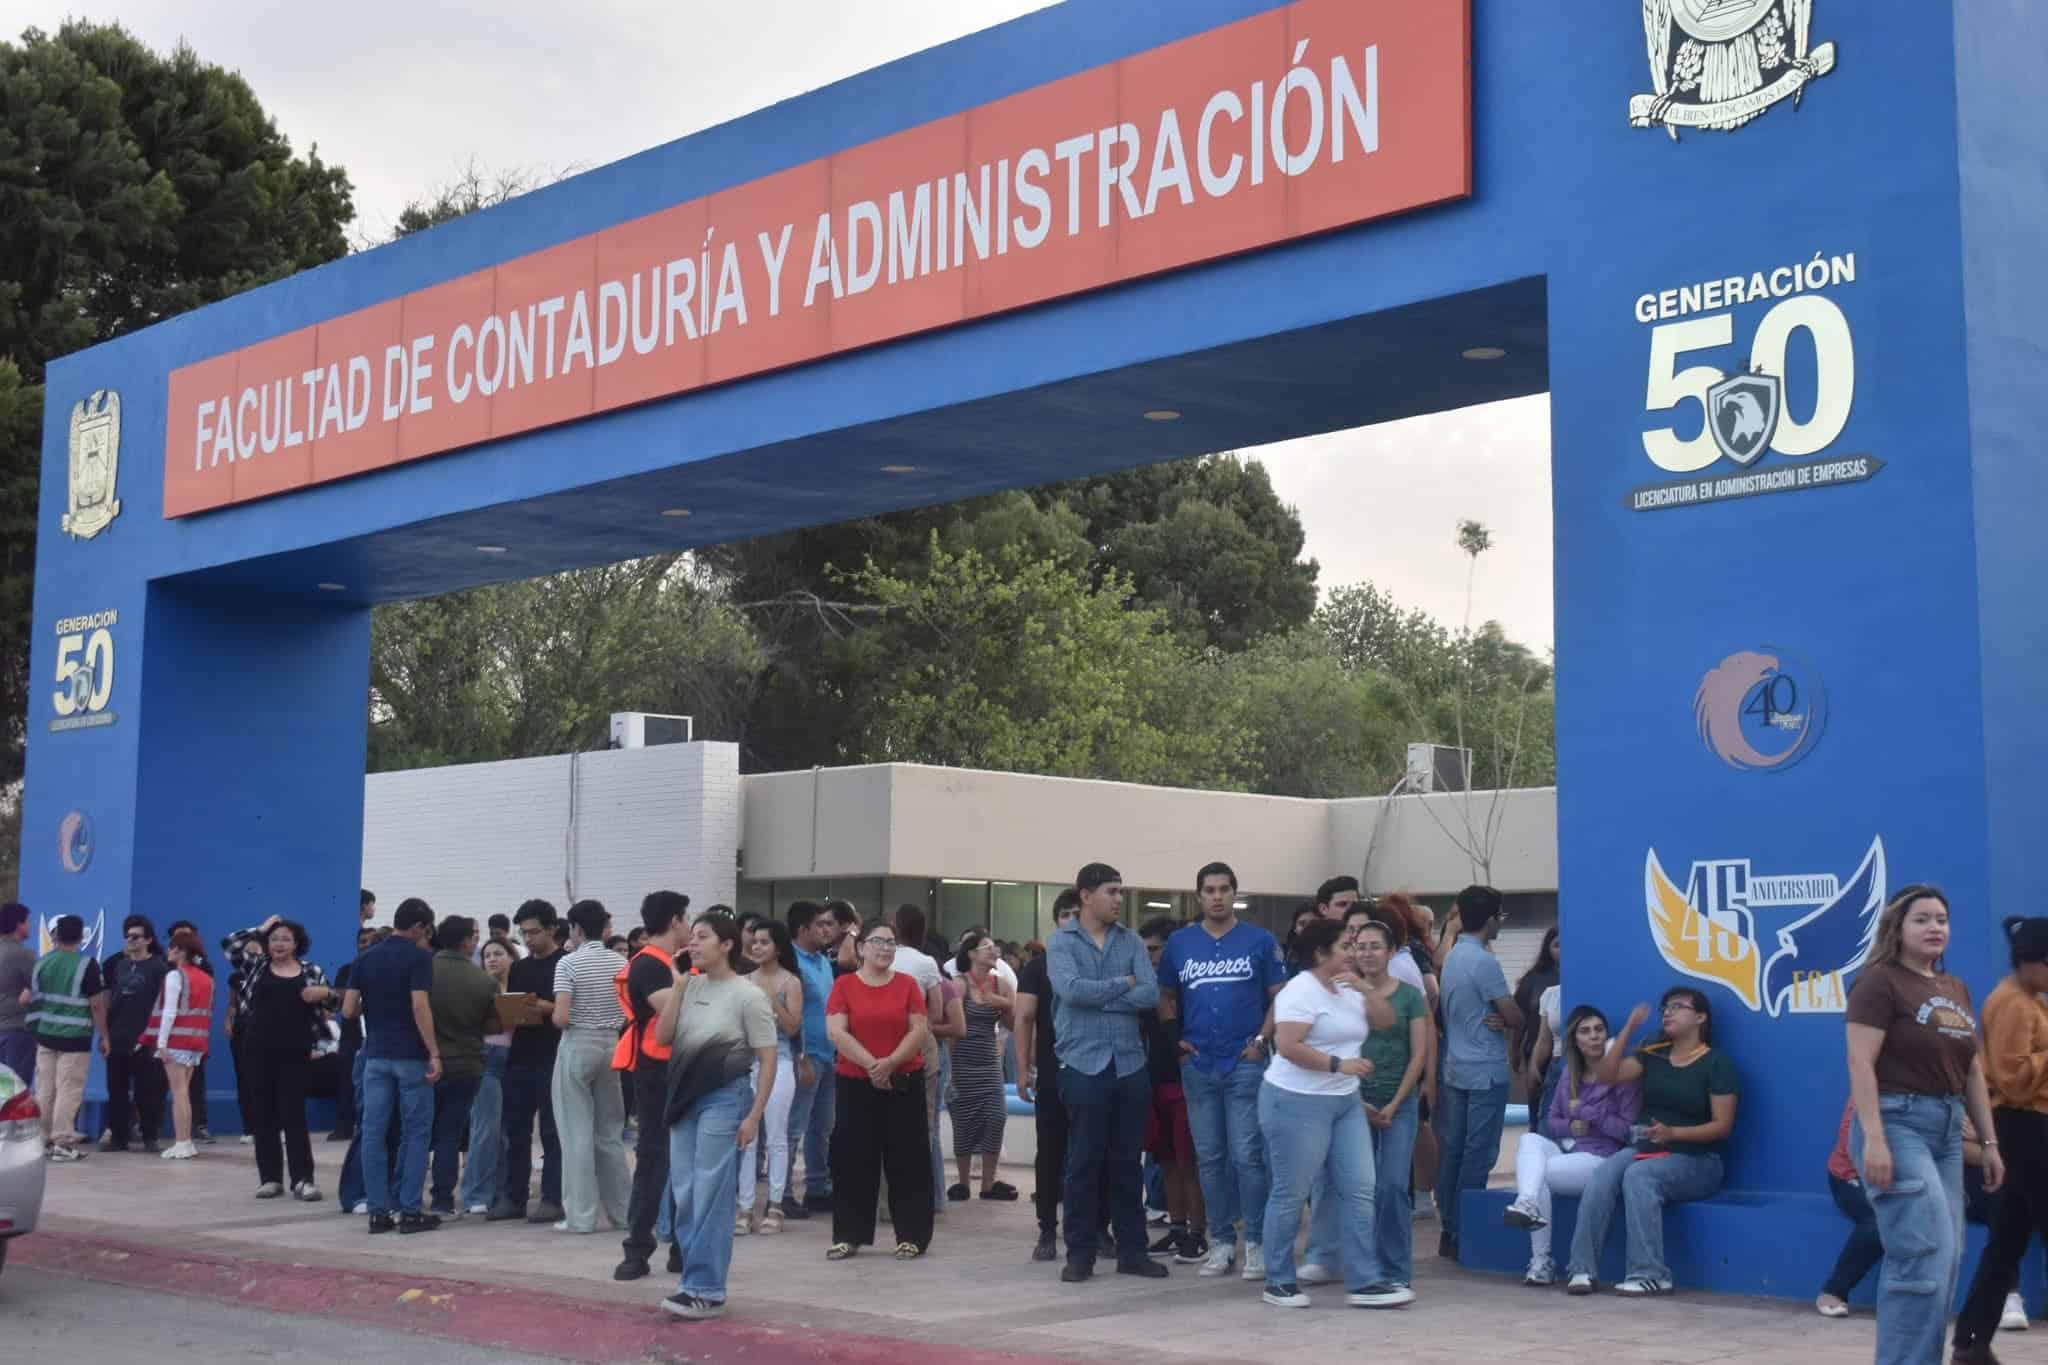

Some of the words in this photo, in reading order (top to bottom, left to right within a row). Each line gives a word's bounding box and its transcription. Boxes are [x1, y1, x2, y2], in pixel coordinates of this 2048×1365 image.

[193, 354, 373, 472] FACULTAD
[382, 334, 436, 422] DE
[446, 227, 749, 405] CONTADURÍA
[757, 223, 794, 317] Y
[803, 39, 1381, 306] ADMINISTRACIÓN
[1635, 251, 1856, 323] GENERACIÓN
[1641, 294, 1855, 473] 50
[1634, 484, 1698, 509] LICENCIATURA
[1699, 481, 1713, 499] EN
[1715, 469, 1795, 498] ADMINISTRACIÓN
[1797, 467, 1811, 485] DE
[1812, 458, 1867, 483] EMPRESAS
[53, 628, 114, 716] 50
[1743, 674, 1797, 727] 40
[1679, 861, 1750, 963] 45
[1751, 879, 1834, 901] ANIVERSARIO
[1178, 955, 1254, 983] Acereros
[1792, 970, 1845, 1009] FCA
